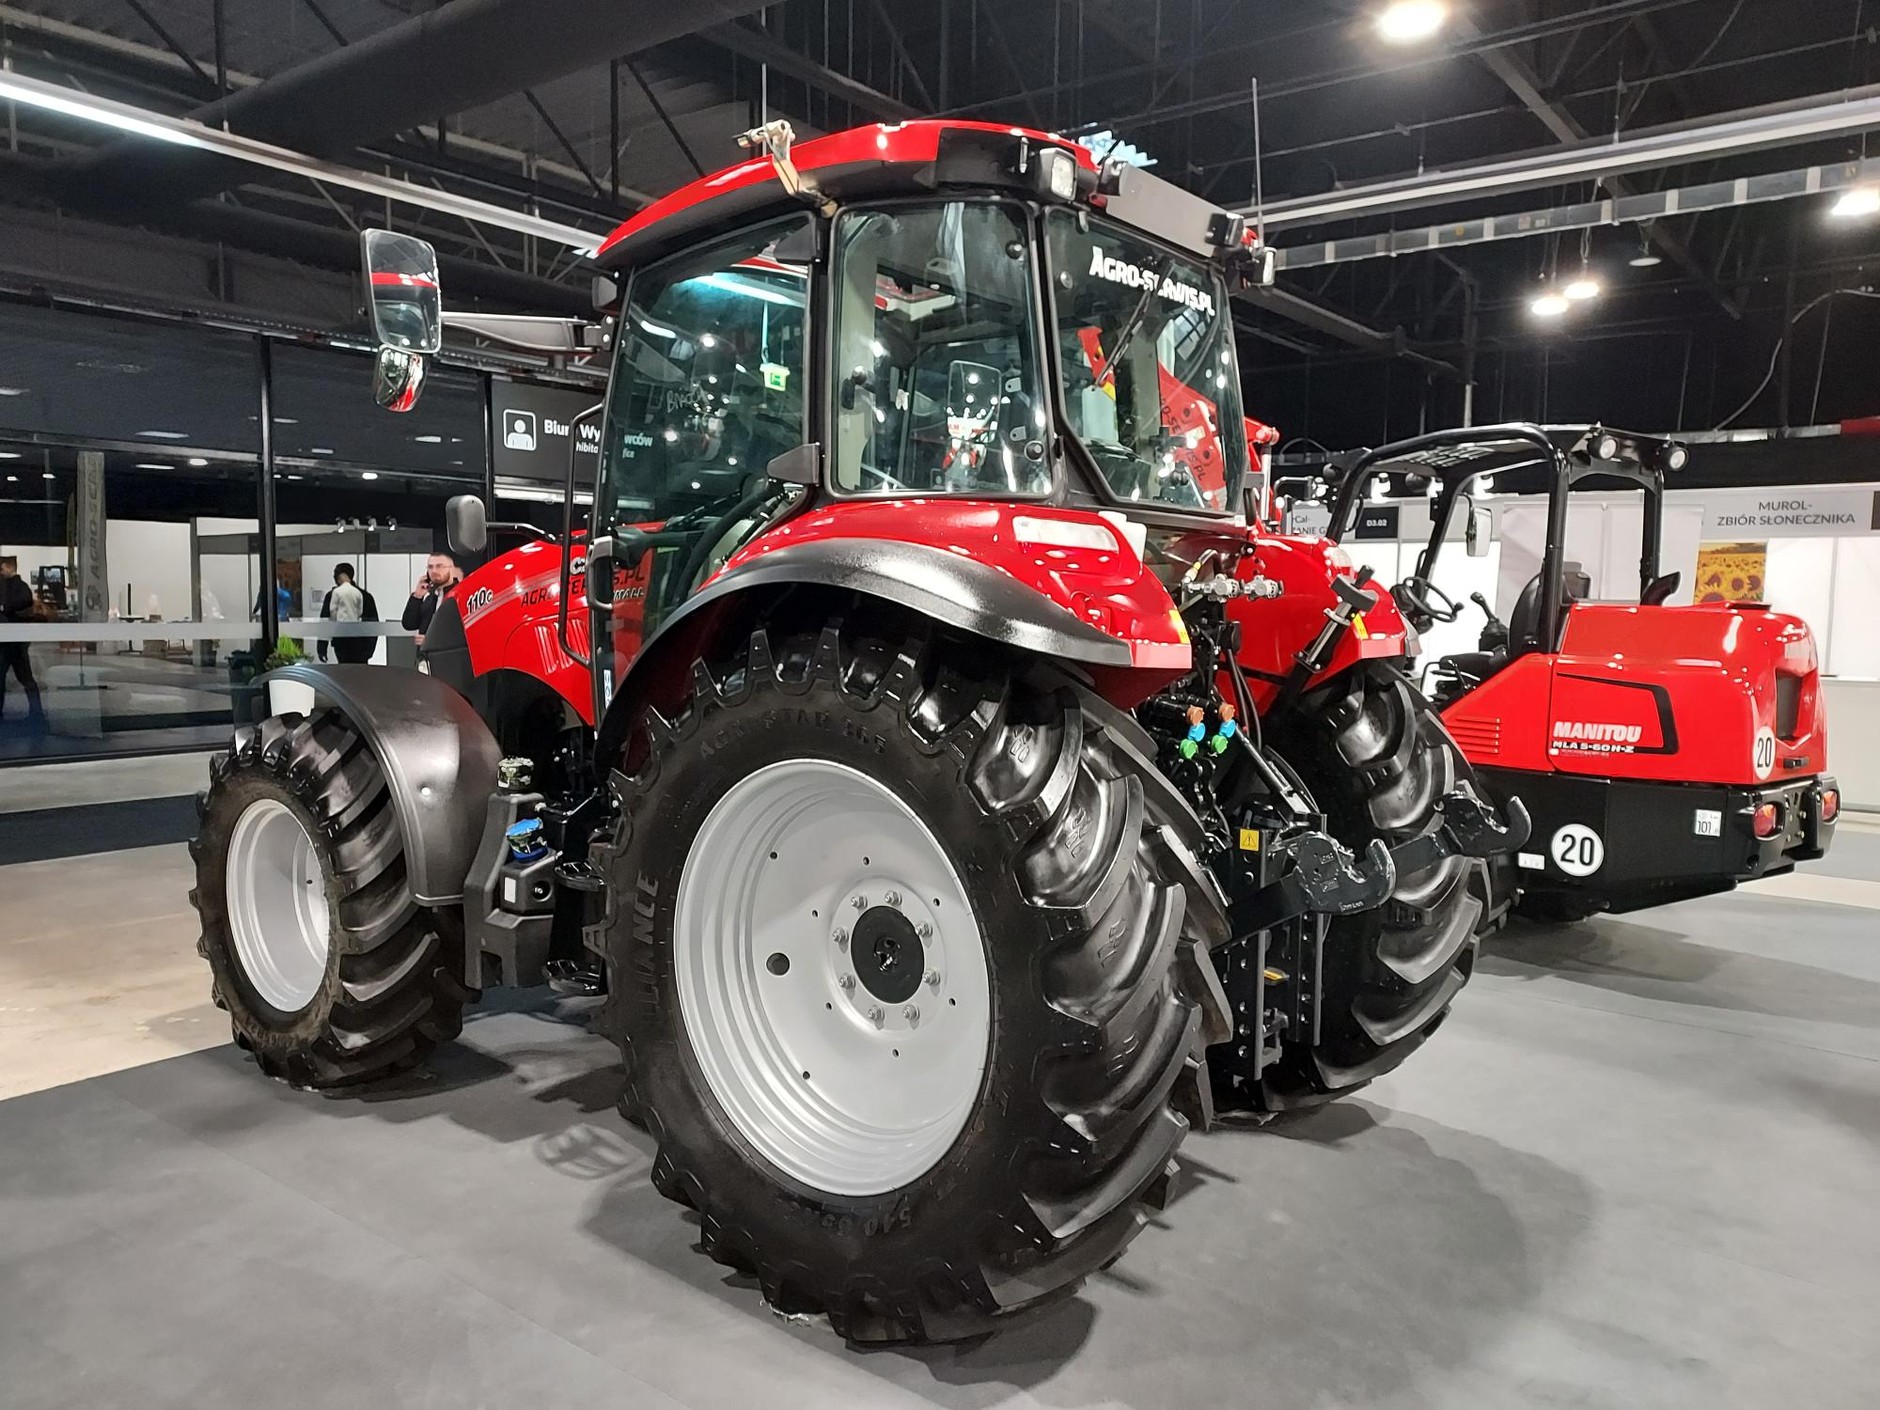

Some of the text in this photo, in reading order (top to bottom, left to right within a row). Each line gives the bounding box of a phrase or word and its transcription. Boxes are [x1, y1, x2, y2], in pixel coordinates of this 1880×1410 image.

[543, 419, 570, 437] Biur
[1717, 513, 1856, 526] ZBIÓR SŁONECZNIKA
[1553, 721, 1642, 743] MANITOU
[1552, 741, 1578, 750] MLA
[1757, 736, 1772, 768] 20
[1697, 820, 1712, 835] 101
[1560, 834, 1595, 866] 20
